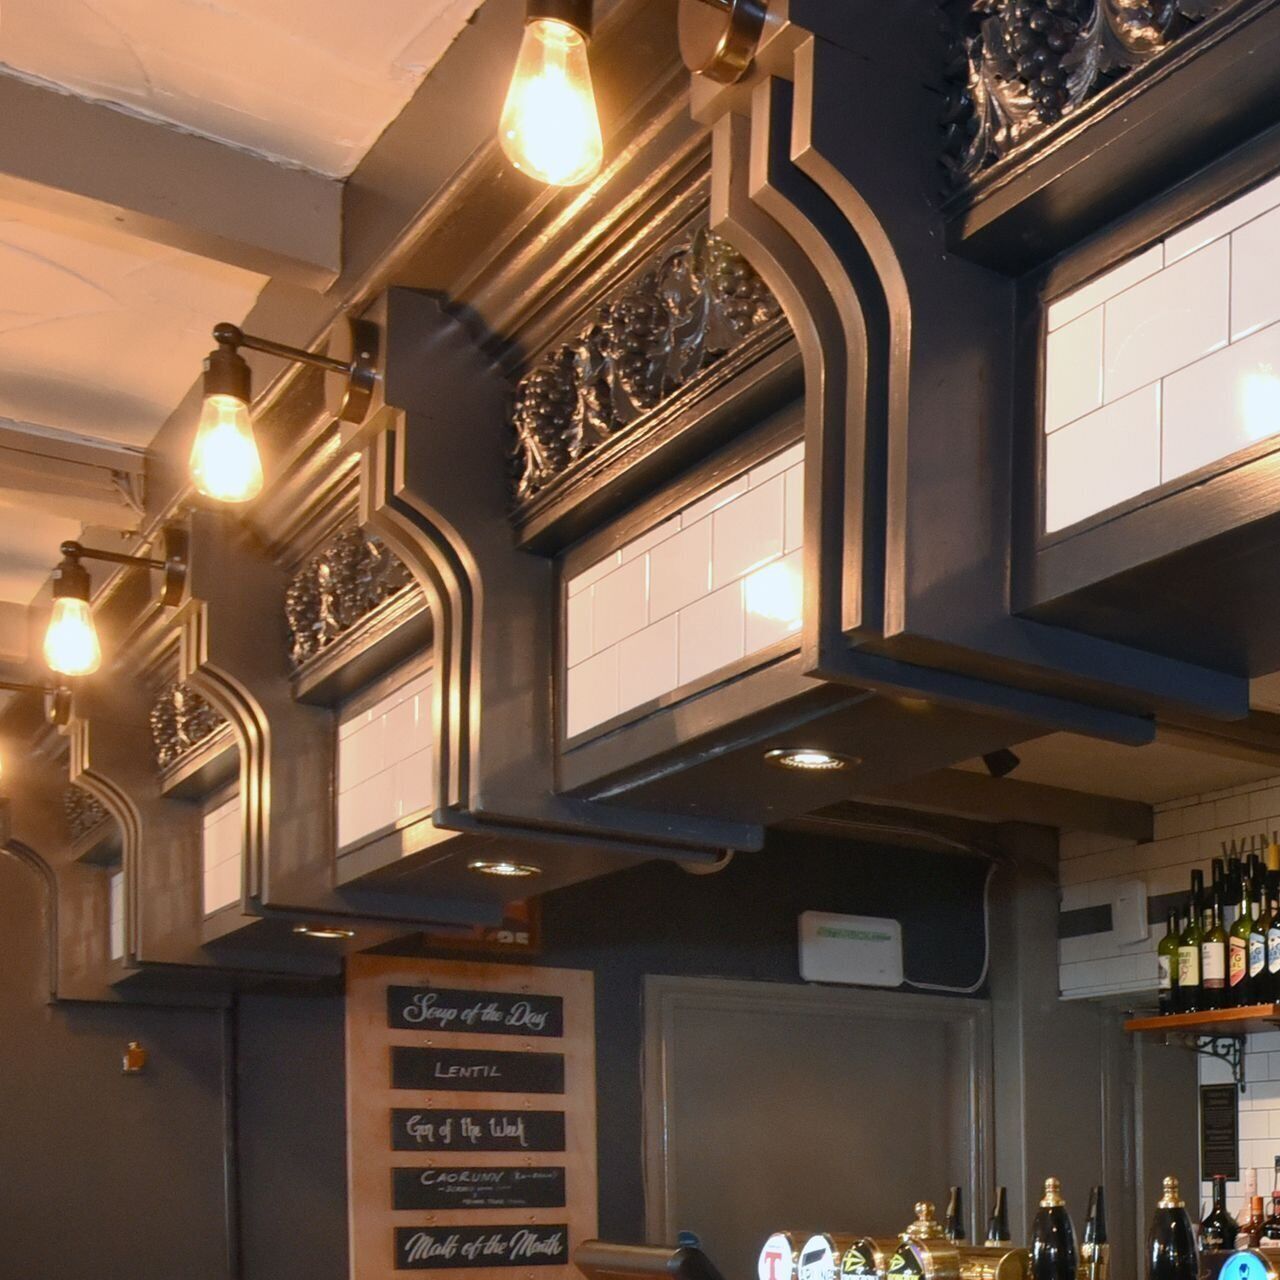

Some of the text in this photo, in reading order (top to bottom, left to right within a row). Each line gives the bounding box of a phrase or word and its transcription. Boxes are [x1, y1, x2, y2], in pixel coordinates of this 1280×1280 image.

[403, 992, 550, 1031] Soup of the Day
[434, 1062, 502, 1079] LENTIL
[406, 1115, 529, 1147] Gin of the Week
[405, 1229, 564, 1263] Malt of the Month
